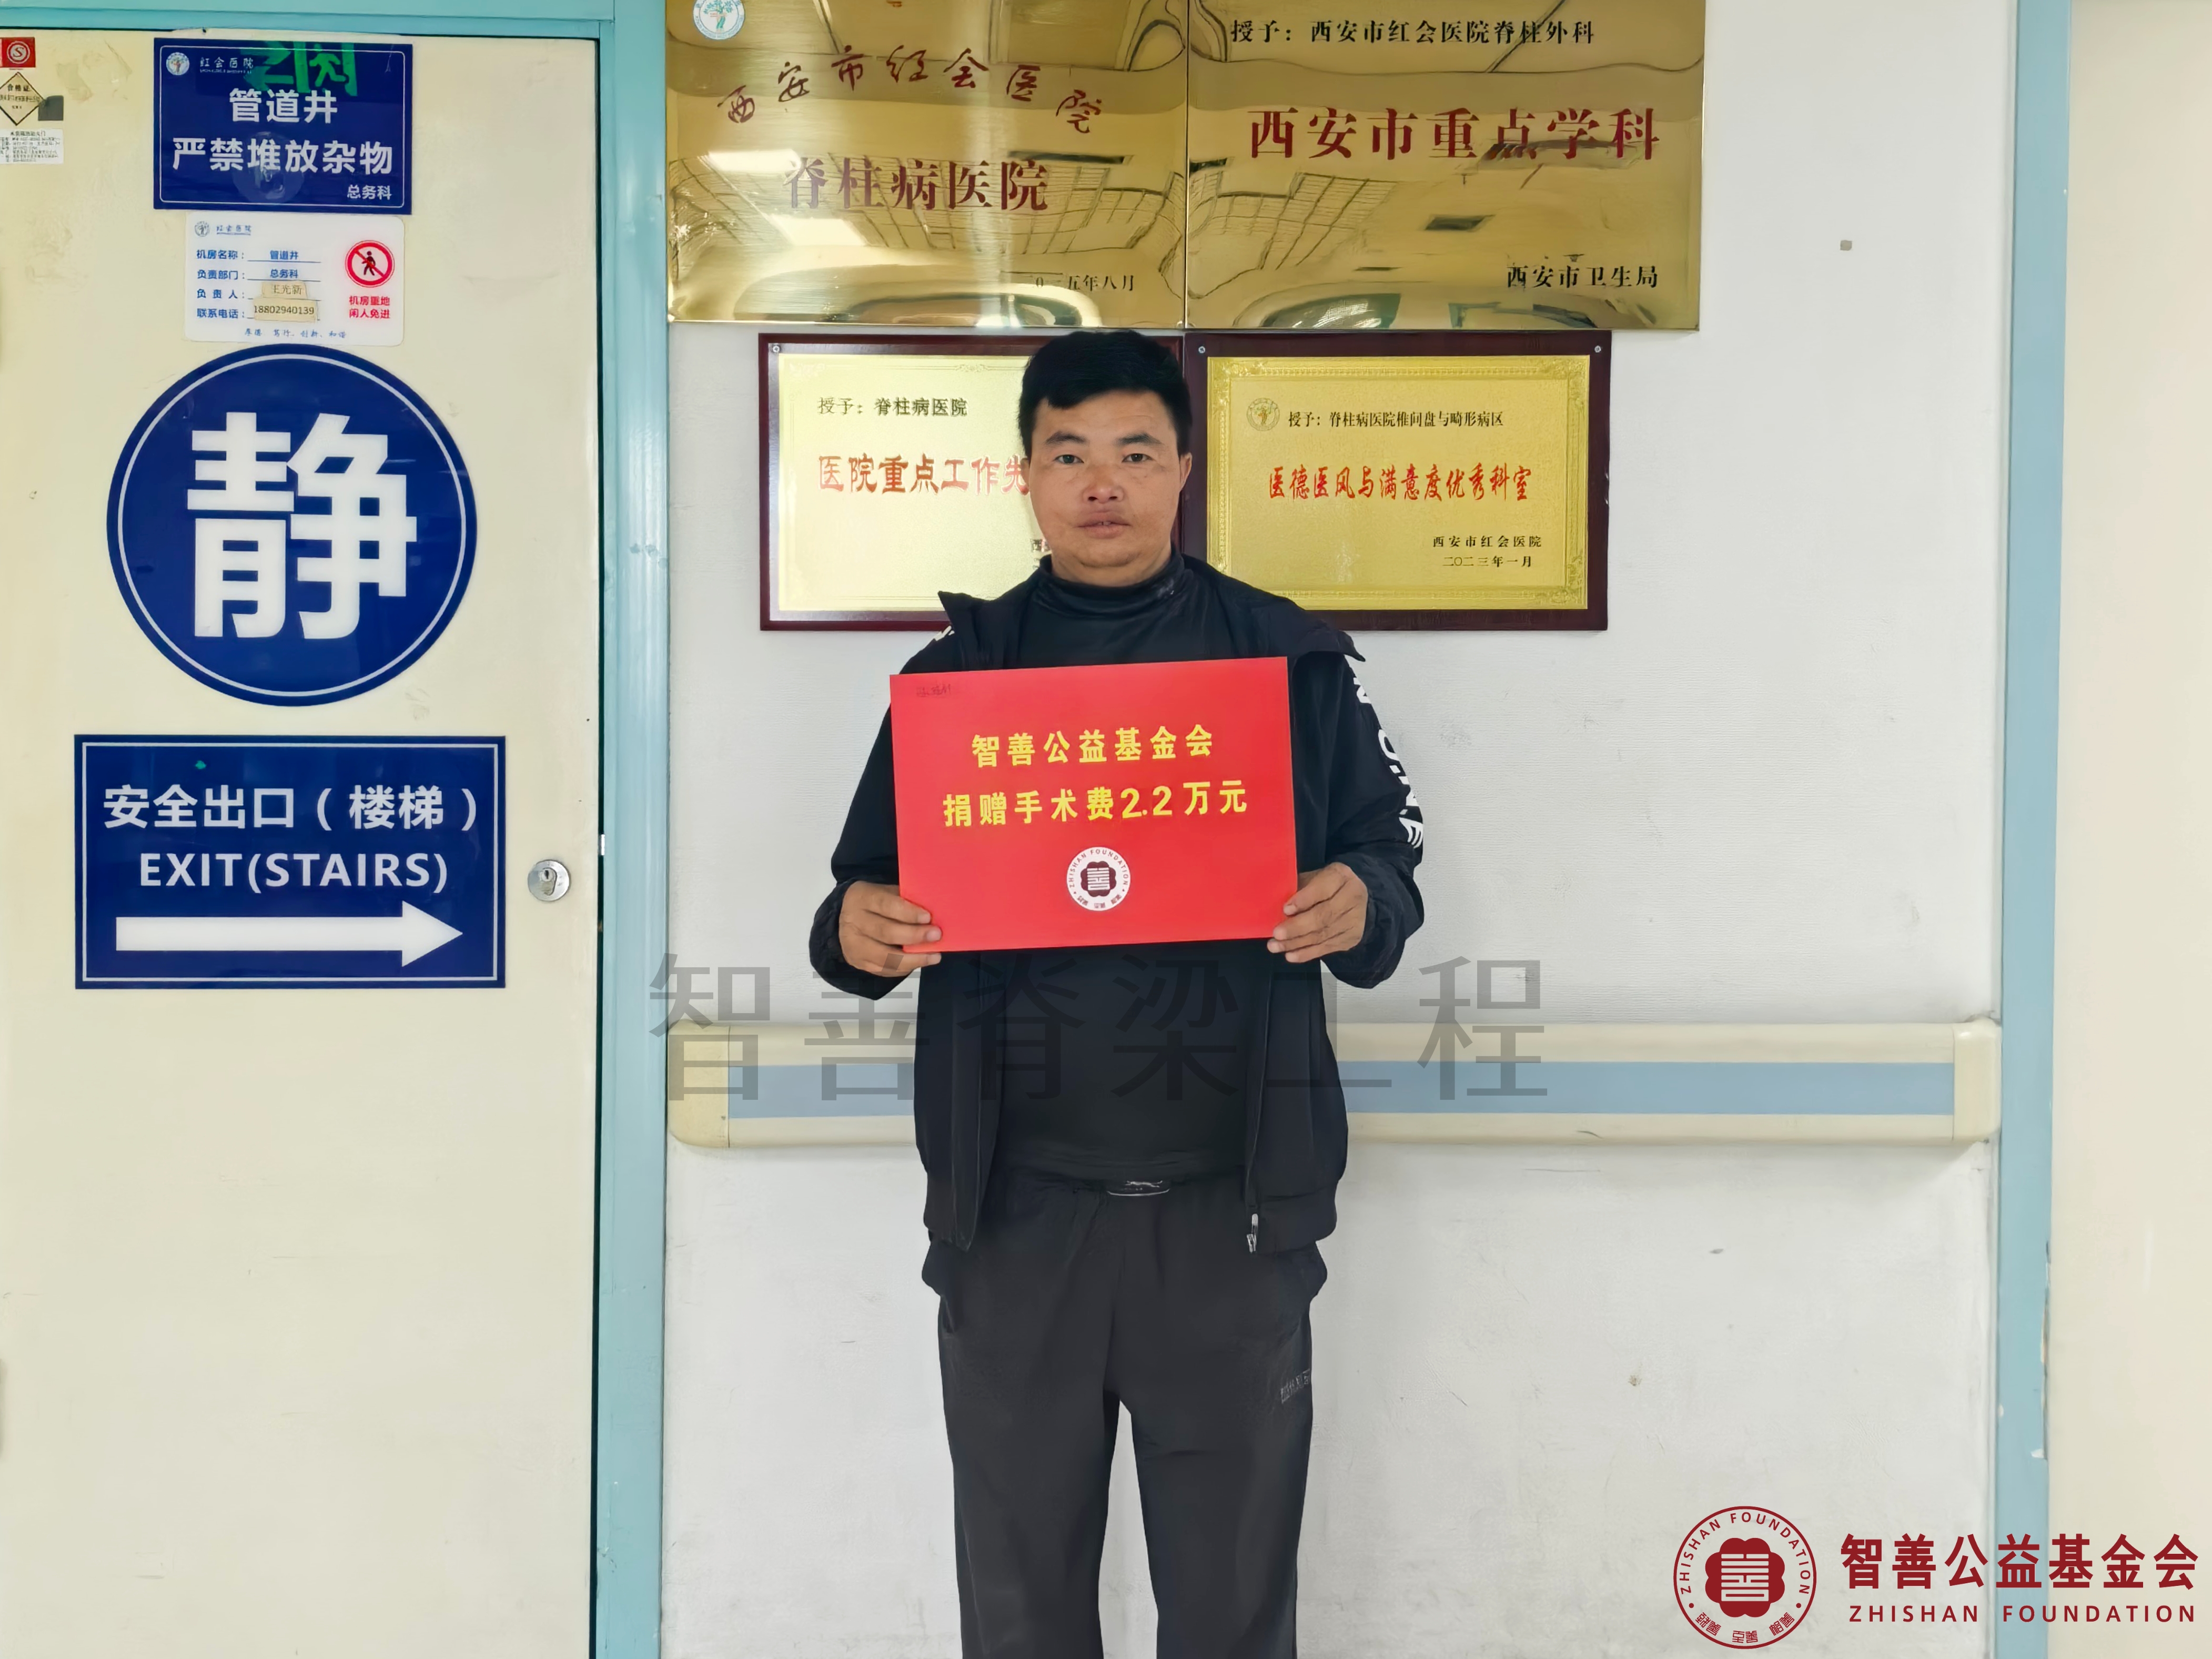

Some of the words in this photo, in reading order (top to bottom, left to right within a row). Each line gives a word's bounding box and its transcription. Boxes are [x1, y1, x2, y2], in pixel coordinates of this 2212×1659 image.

[1231, 19, 1594, 44] 授予：西安市红会医院脊柱外科
[229, 88, 338, 124] 管道井
[716, 44, 1101, 135] 西安市红会医院
[1247, 107, 1660, 160] 西安市重点学科
[173, 137, 392, 175] 严禁堆放杂物
[347, 185, 392, 200] 总务科
[784, 157, 1049, 211] 脊柱病医院
[270, 250, 299, 260] 管道井
[270, 269, 299, 279] 总务科
[1506, 265, 1658, 289] 西安市卫生局
[254, 305, 315, 315] 18802940139
[349, 296, 390, 306] 机房重地
[349, 308, 390, 319] 闲人免进
[817, 397, 968, 417] 授予：脊柱病医院
[1268, 462, 1532, 502] 医德医风与满意度优秀科室
[187, 411, 417, 640] 静
[1432, 535, 1542, 548] 西安市红会医院
[971, 724, 1213, 768] 智善公益基金会
[103, 783, 477, 831] 安全出口（楼梯）
[942, 779, 1248, 827] 捐赠手术费2.2万元
[139, 853, 448, 894] EXIT(STAIRS)
[1068, 853, 1087, 888] ZHISHAN
[1090, 849, 1129, 885] FOUNDATION
